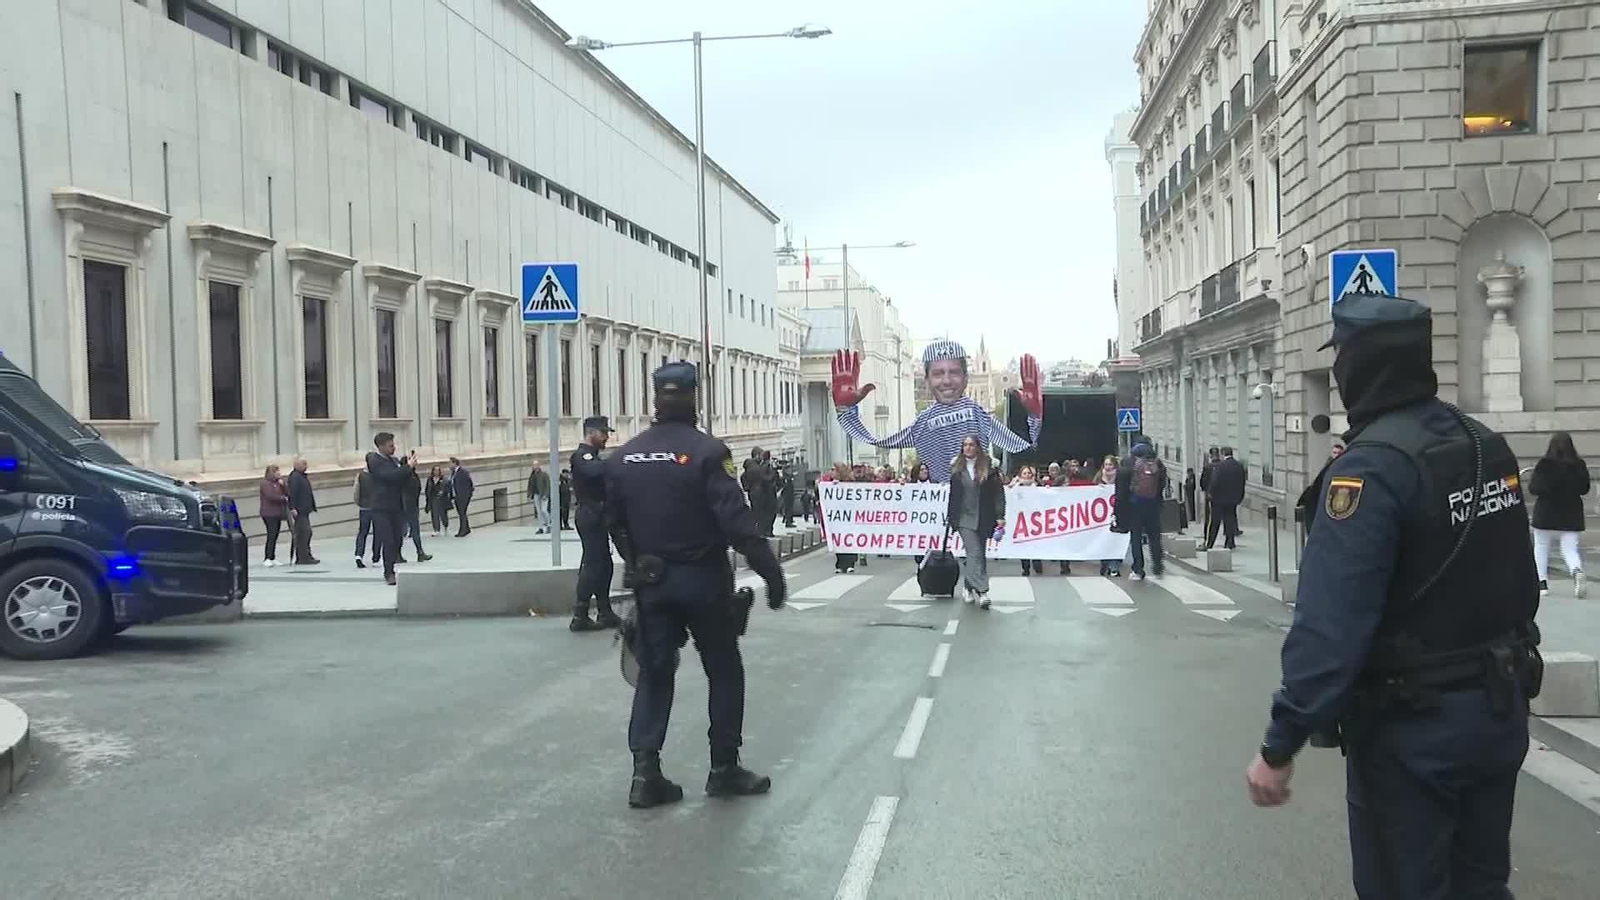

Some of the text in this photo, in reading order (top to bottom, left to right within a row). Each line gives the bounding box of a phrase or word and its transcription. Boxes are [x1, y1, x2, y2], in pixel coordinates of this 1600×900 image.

[824, 487, 902, 501] NUESTROS
[854, 510, 908, 523] MUERTO
[911, 511, 938, 524] POR
